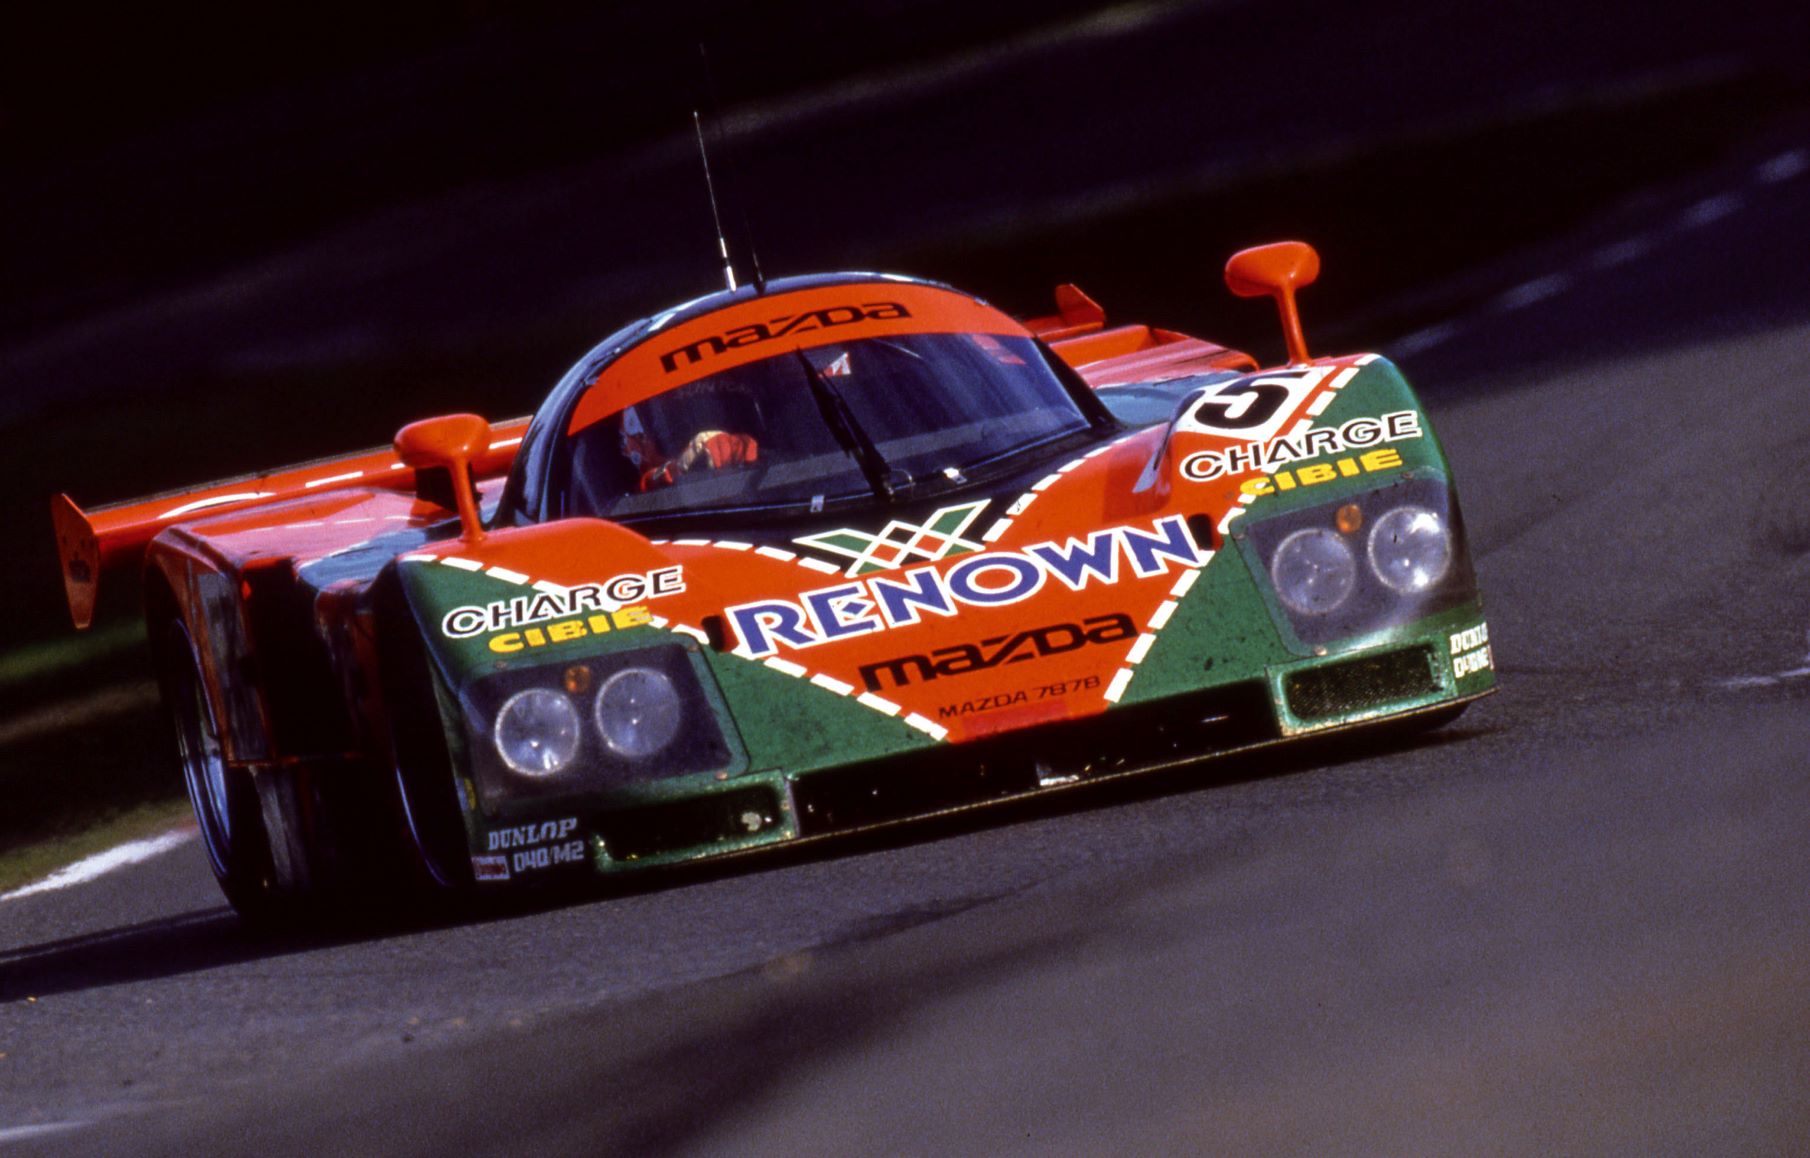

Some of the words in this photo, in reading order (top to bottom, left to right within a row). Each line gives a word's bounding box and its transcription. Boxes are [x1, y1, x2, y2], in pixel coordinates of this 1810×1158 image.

[660, 301, 912, 374] mazda
[1172, 371, 1310, 429] 5
[1181, 410, 1421, 481] CHARGE
[1240, 448, 1403, 496] CIBIE
[442, 565, 686, 638] CHARGE
[726, 514, 1206, 658] RENOWN
[488, 606, 653, 653] CIBIE
[859, 612, 1139, 692] mazda
[938, 689, 1029, 718] MAZDA
[1033, 675, 1101, 699] 787B
[487, 816, 578, 851] DUNLOP
